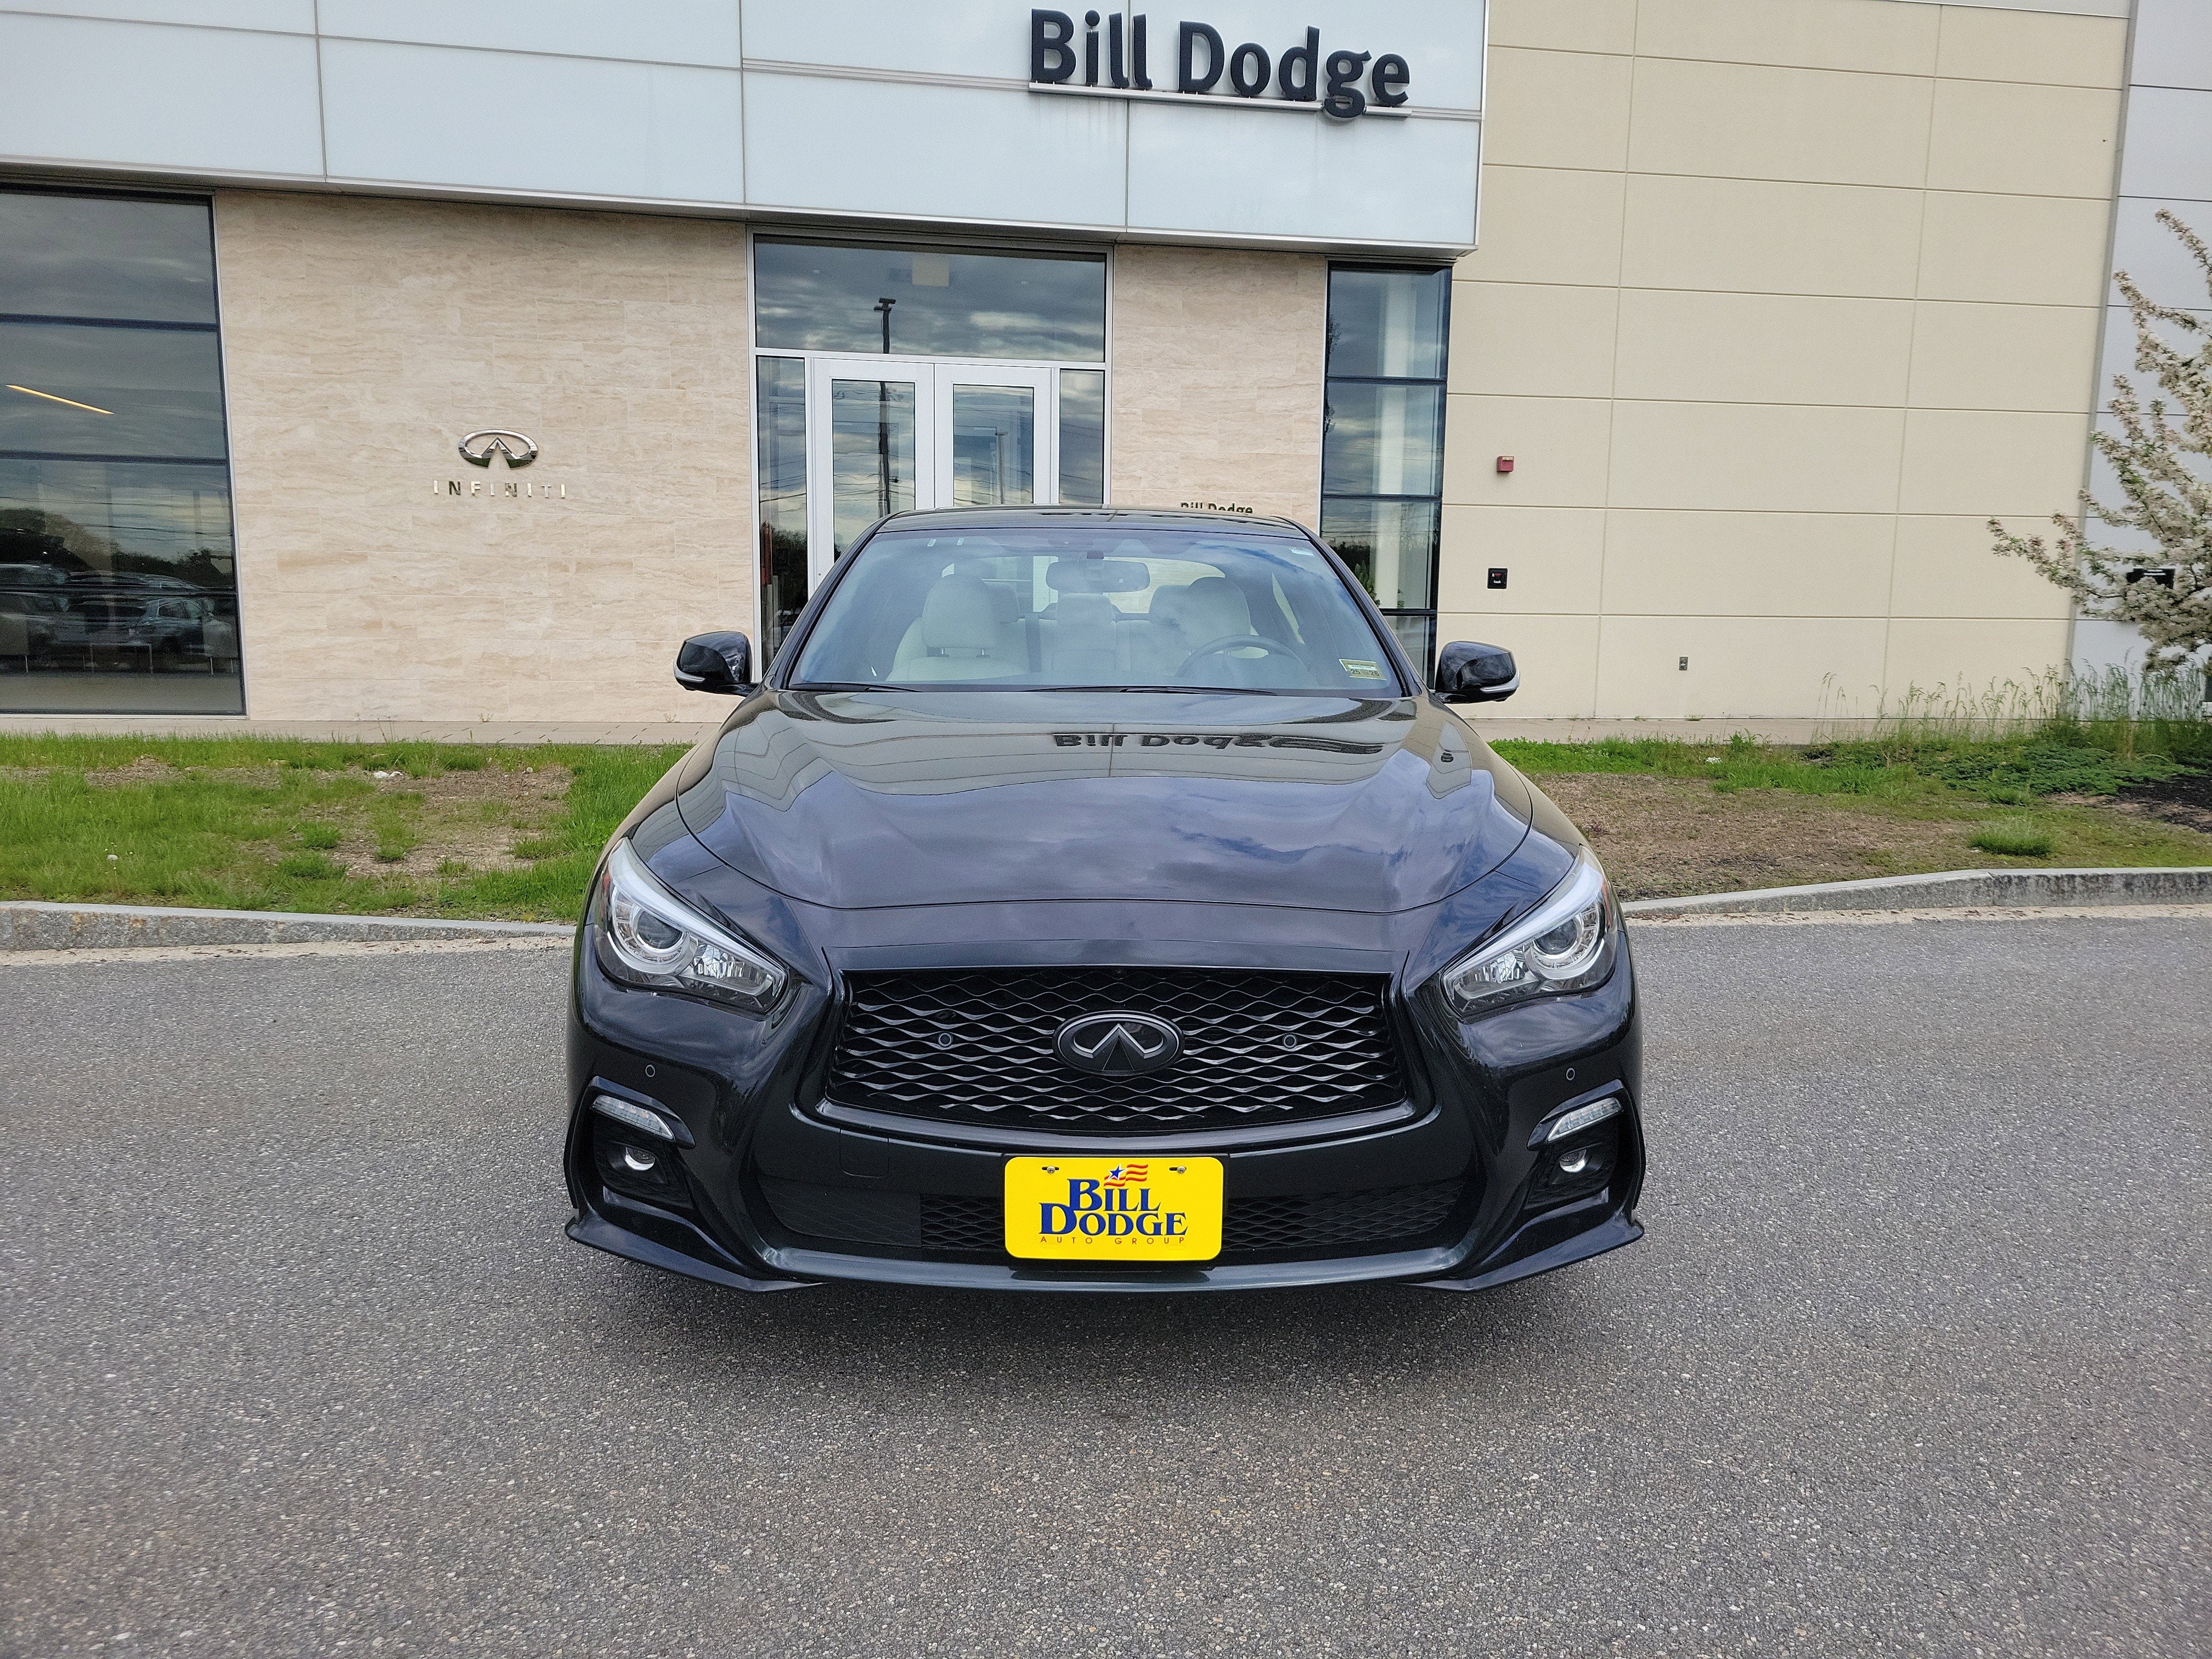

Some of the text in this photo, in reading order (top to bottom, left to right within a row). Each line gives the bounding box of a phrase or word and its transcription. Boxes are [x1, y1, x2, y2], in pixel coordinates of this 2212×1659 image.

[1031, 8, 1410, 119] Bill Dodge
[433, 480, 566, 498] INFINITI
[1066, 1178, 1161, 1212] BILL
[1038, 1202, 1189, 1236] DODGE
[1040, 1235, 1185, 1245] AUTO GROUP
